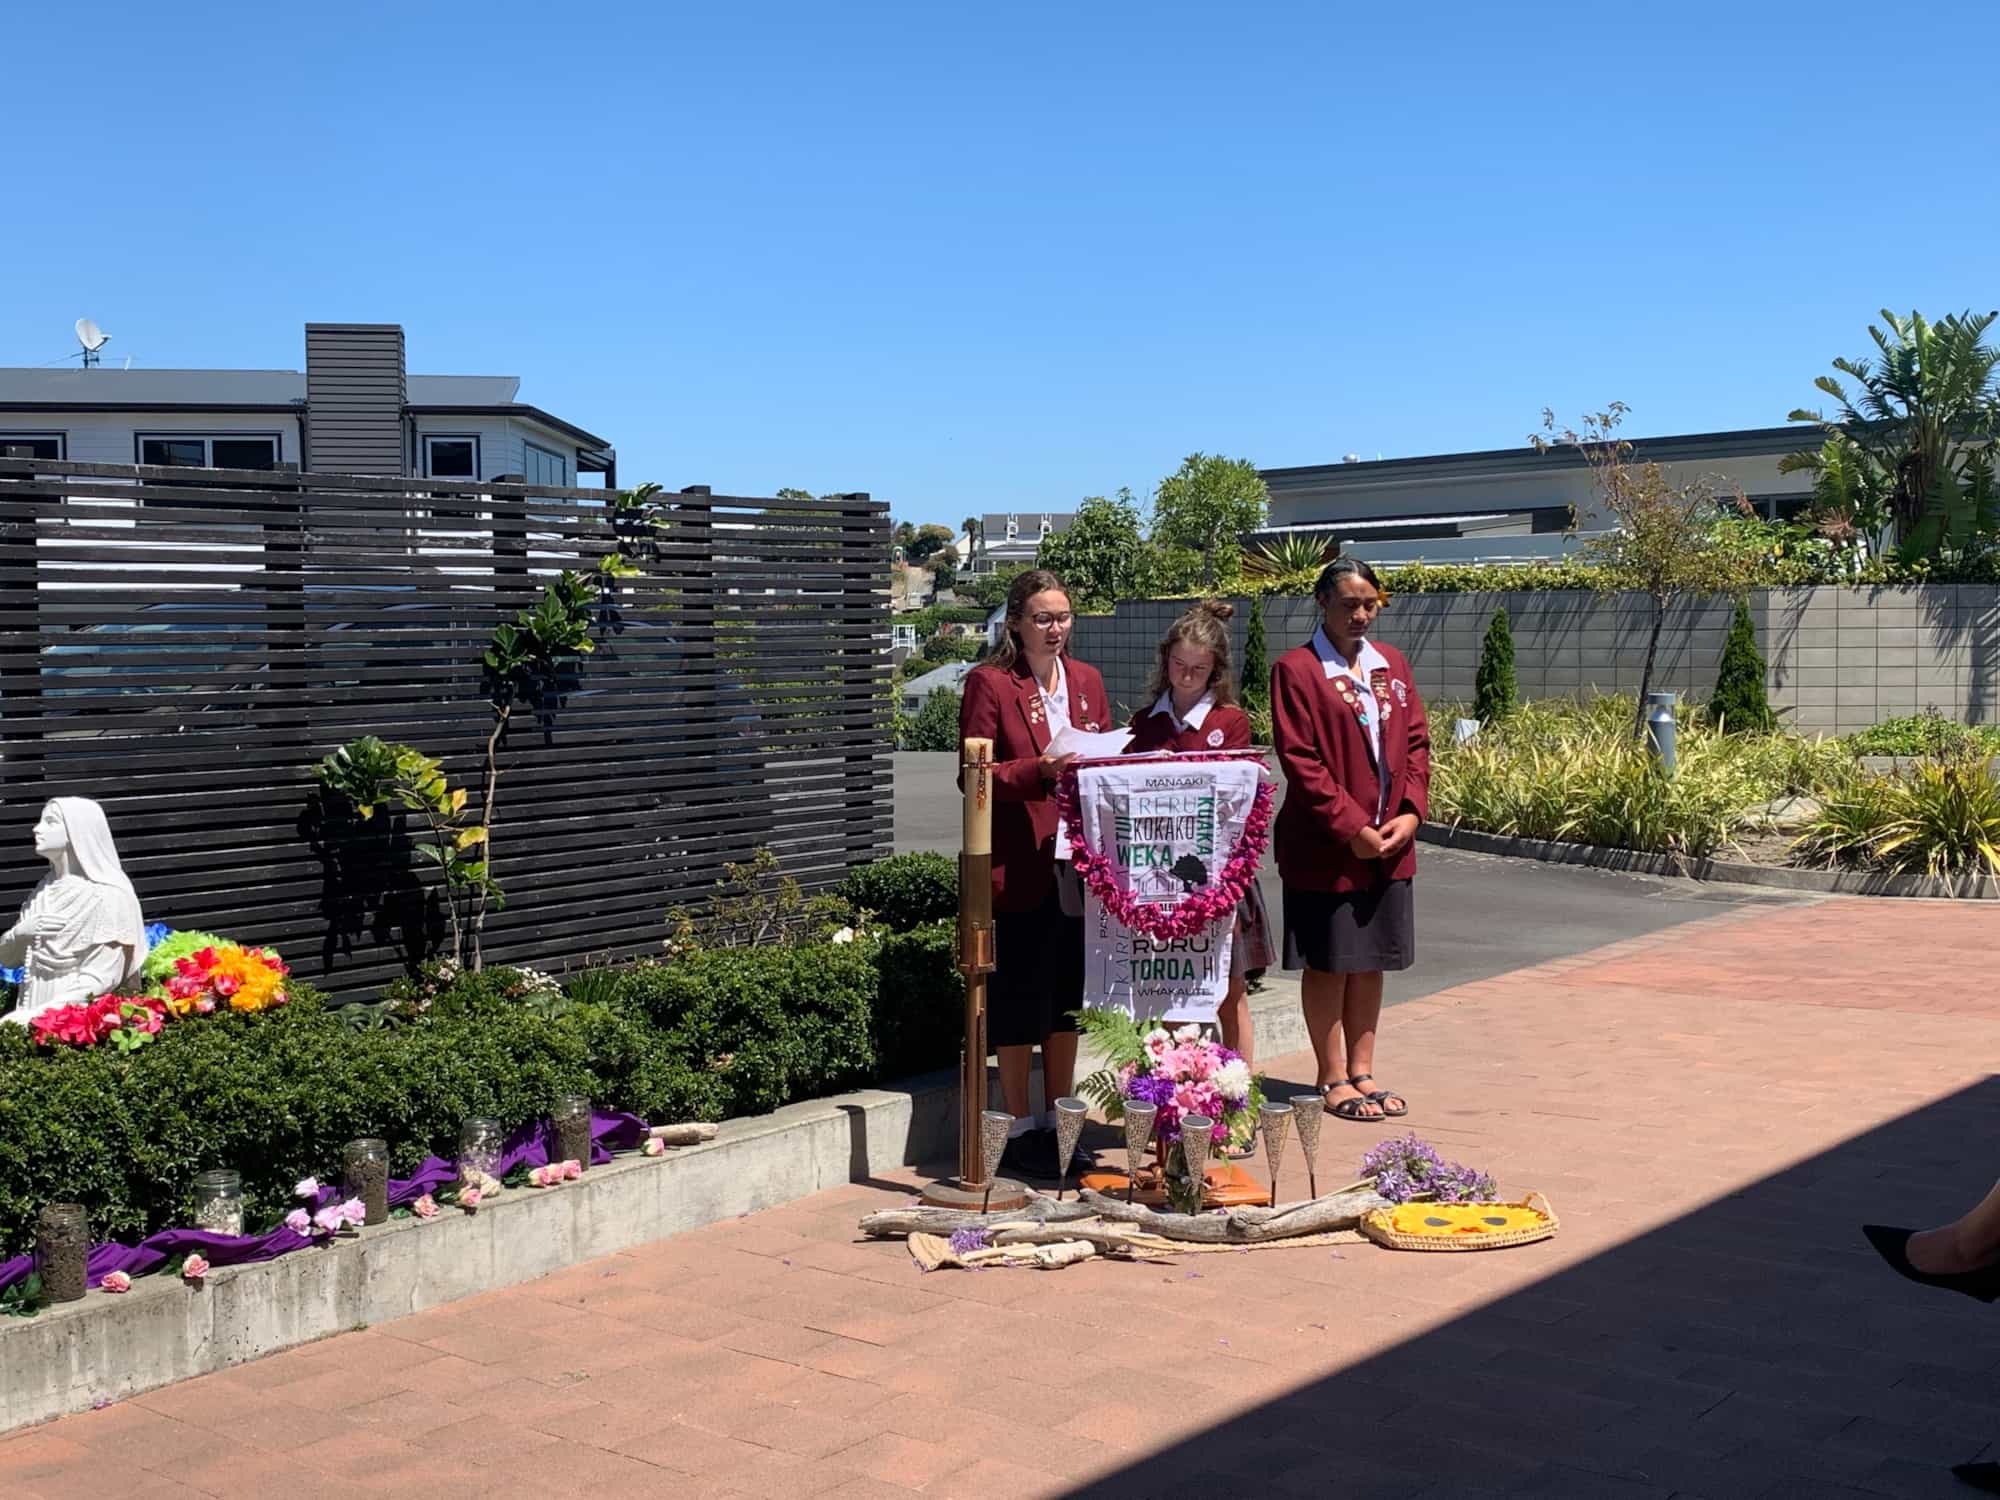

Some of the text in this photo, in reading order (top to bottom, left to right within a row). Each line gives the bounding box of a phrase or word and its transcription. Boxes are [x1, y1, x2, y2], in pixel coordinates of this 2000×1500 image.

[1145, 777, 1204, 788] MANAAKI
[1115, 816, 1132, 841] TUI
[1134, 815, 1195, 841] KOKAKO
[1197, 795, 1214, 856] KUAKA
[1116, 844, 1174, 868] WEKA
[1133, 938, 1209, 955] RURU
[1130, 958, 1196, 981] TOROA
